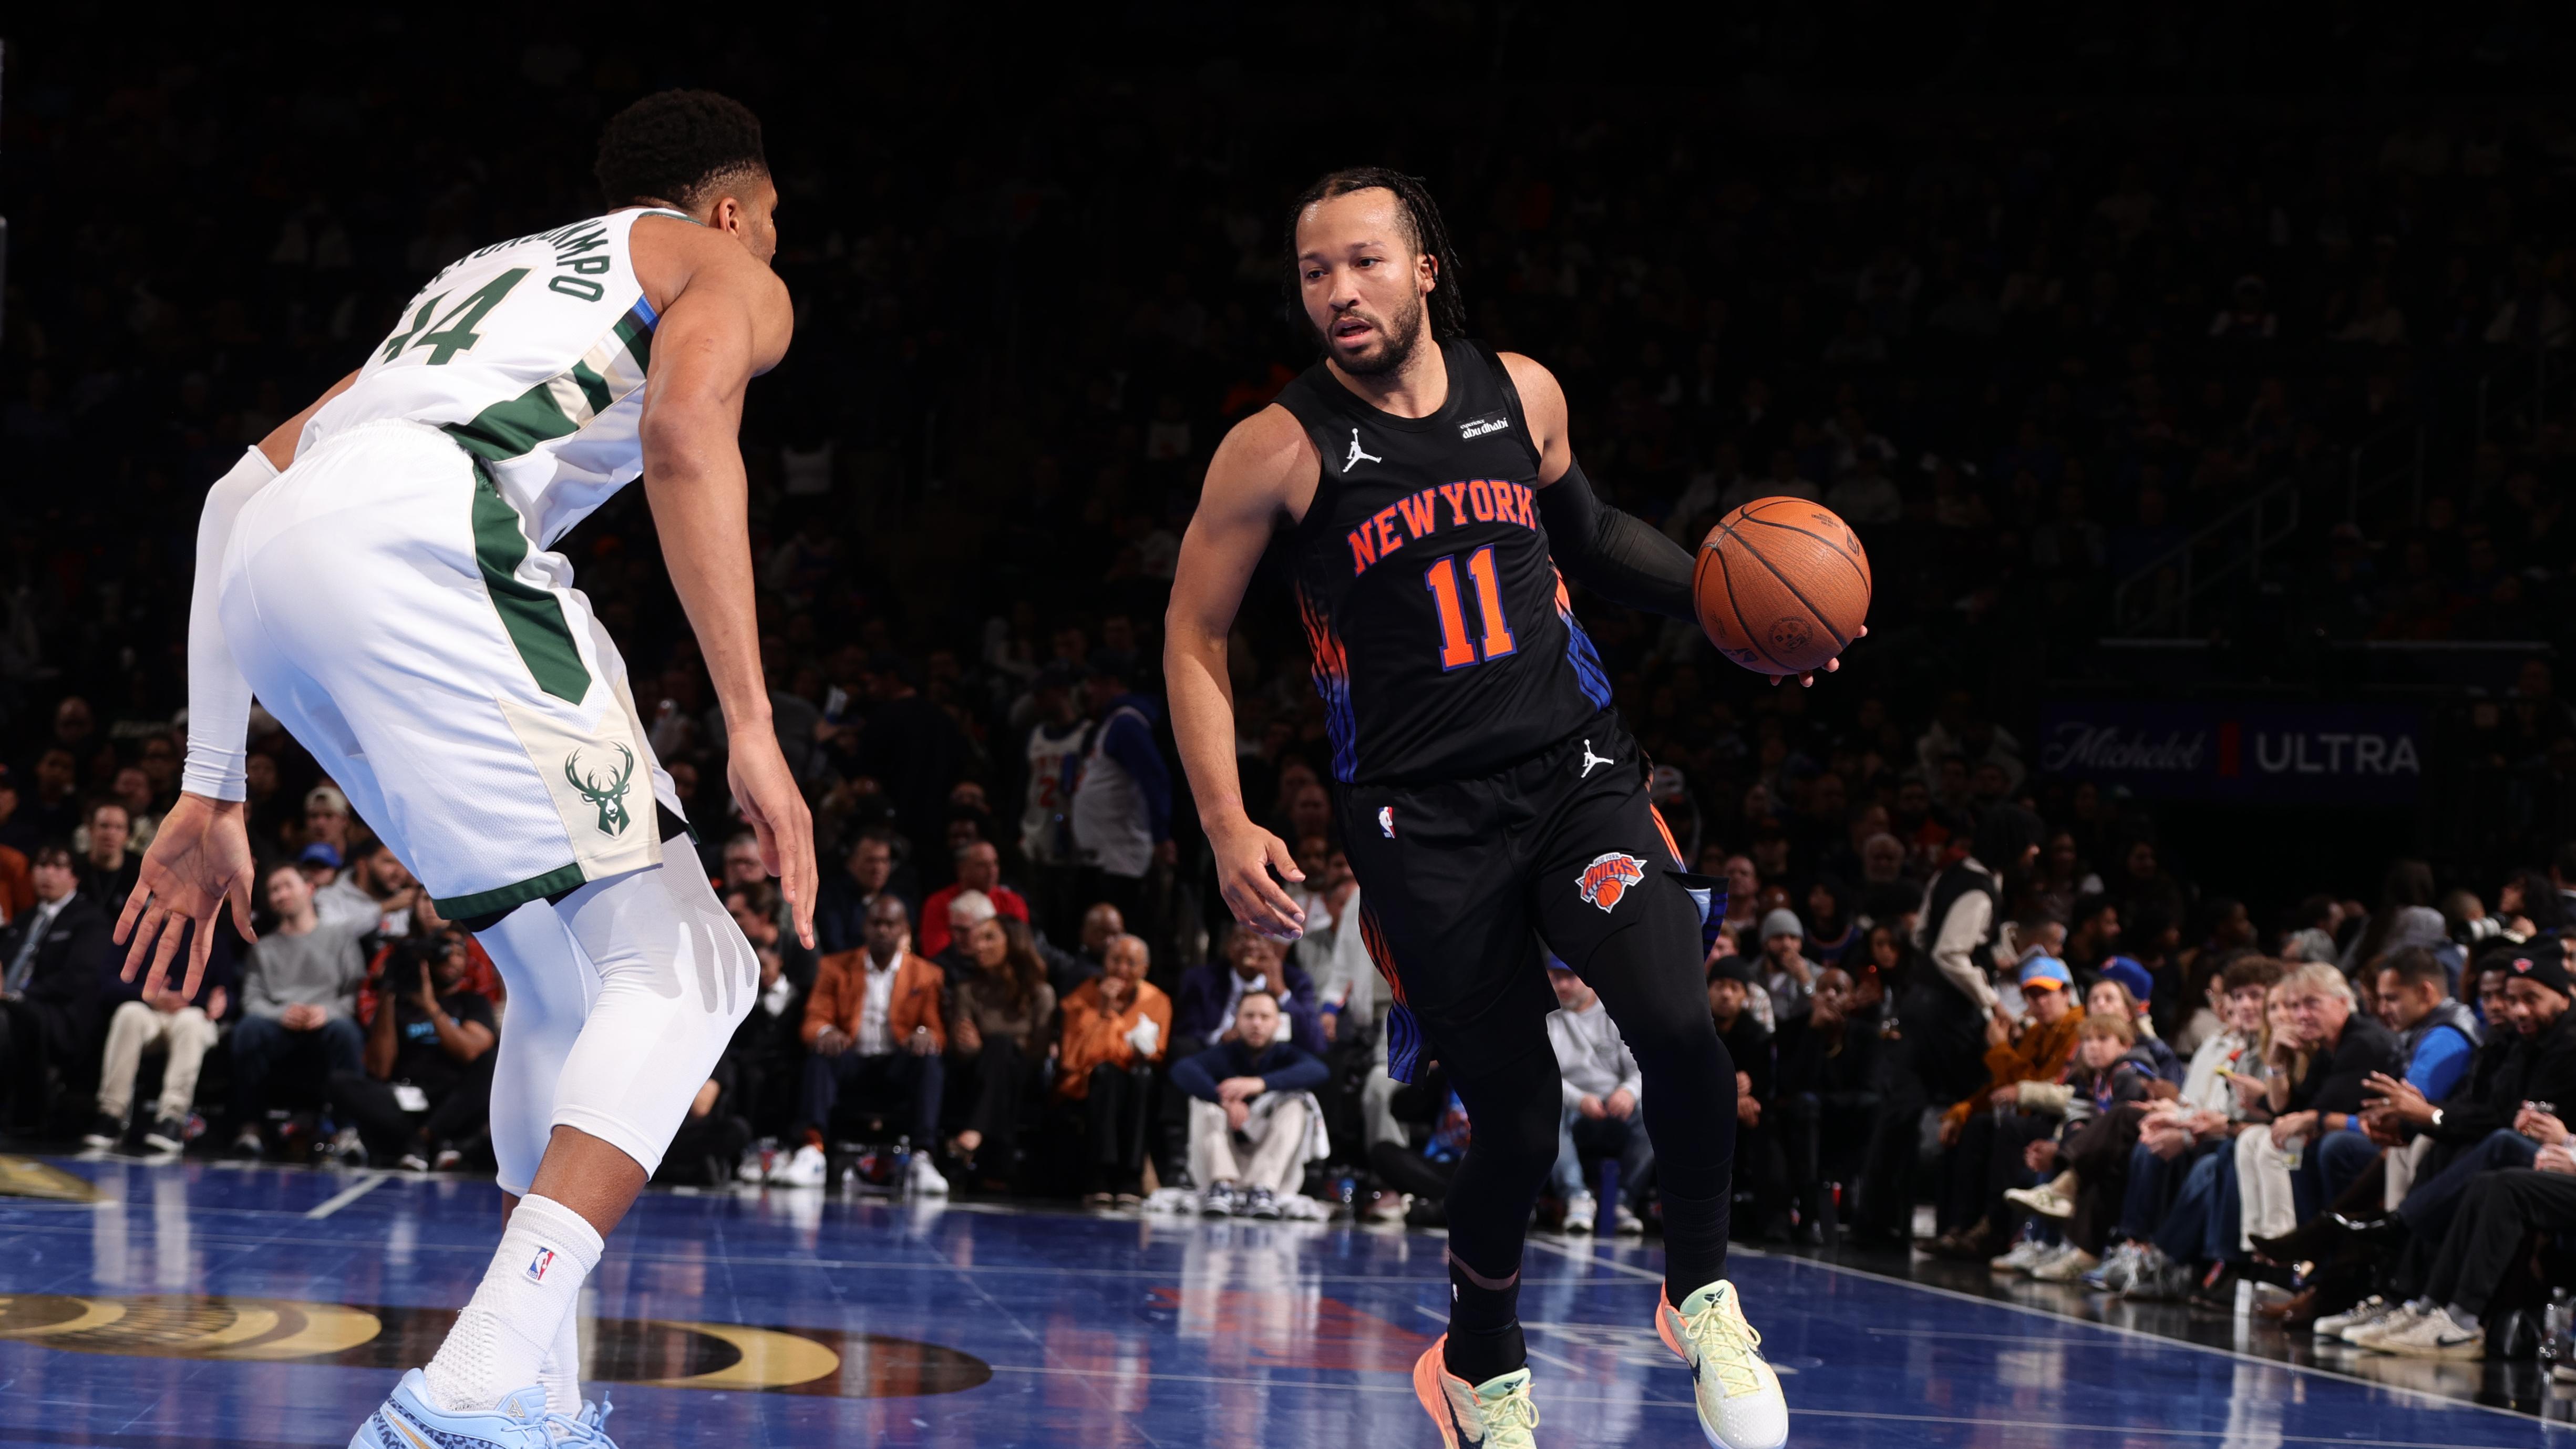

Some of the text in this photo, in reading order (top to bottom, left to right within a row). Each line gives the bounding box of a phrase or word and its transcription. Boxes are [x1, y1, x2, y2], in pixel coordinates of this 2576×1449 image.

[1460, 419, 1485, 429] experience
[1462, 417, 1509, 439] abu dhabi
[1346, 479, 1536, 577] NEW YORK
[1424, 543, 1518, 672] 11
[2256, 731, 2420, 776] ULTRA
[1582, 856, 1641, 897] KNICKS
